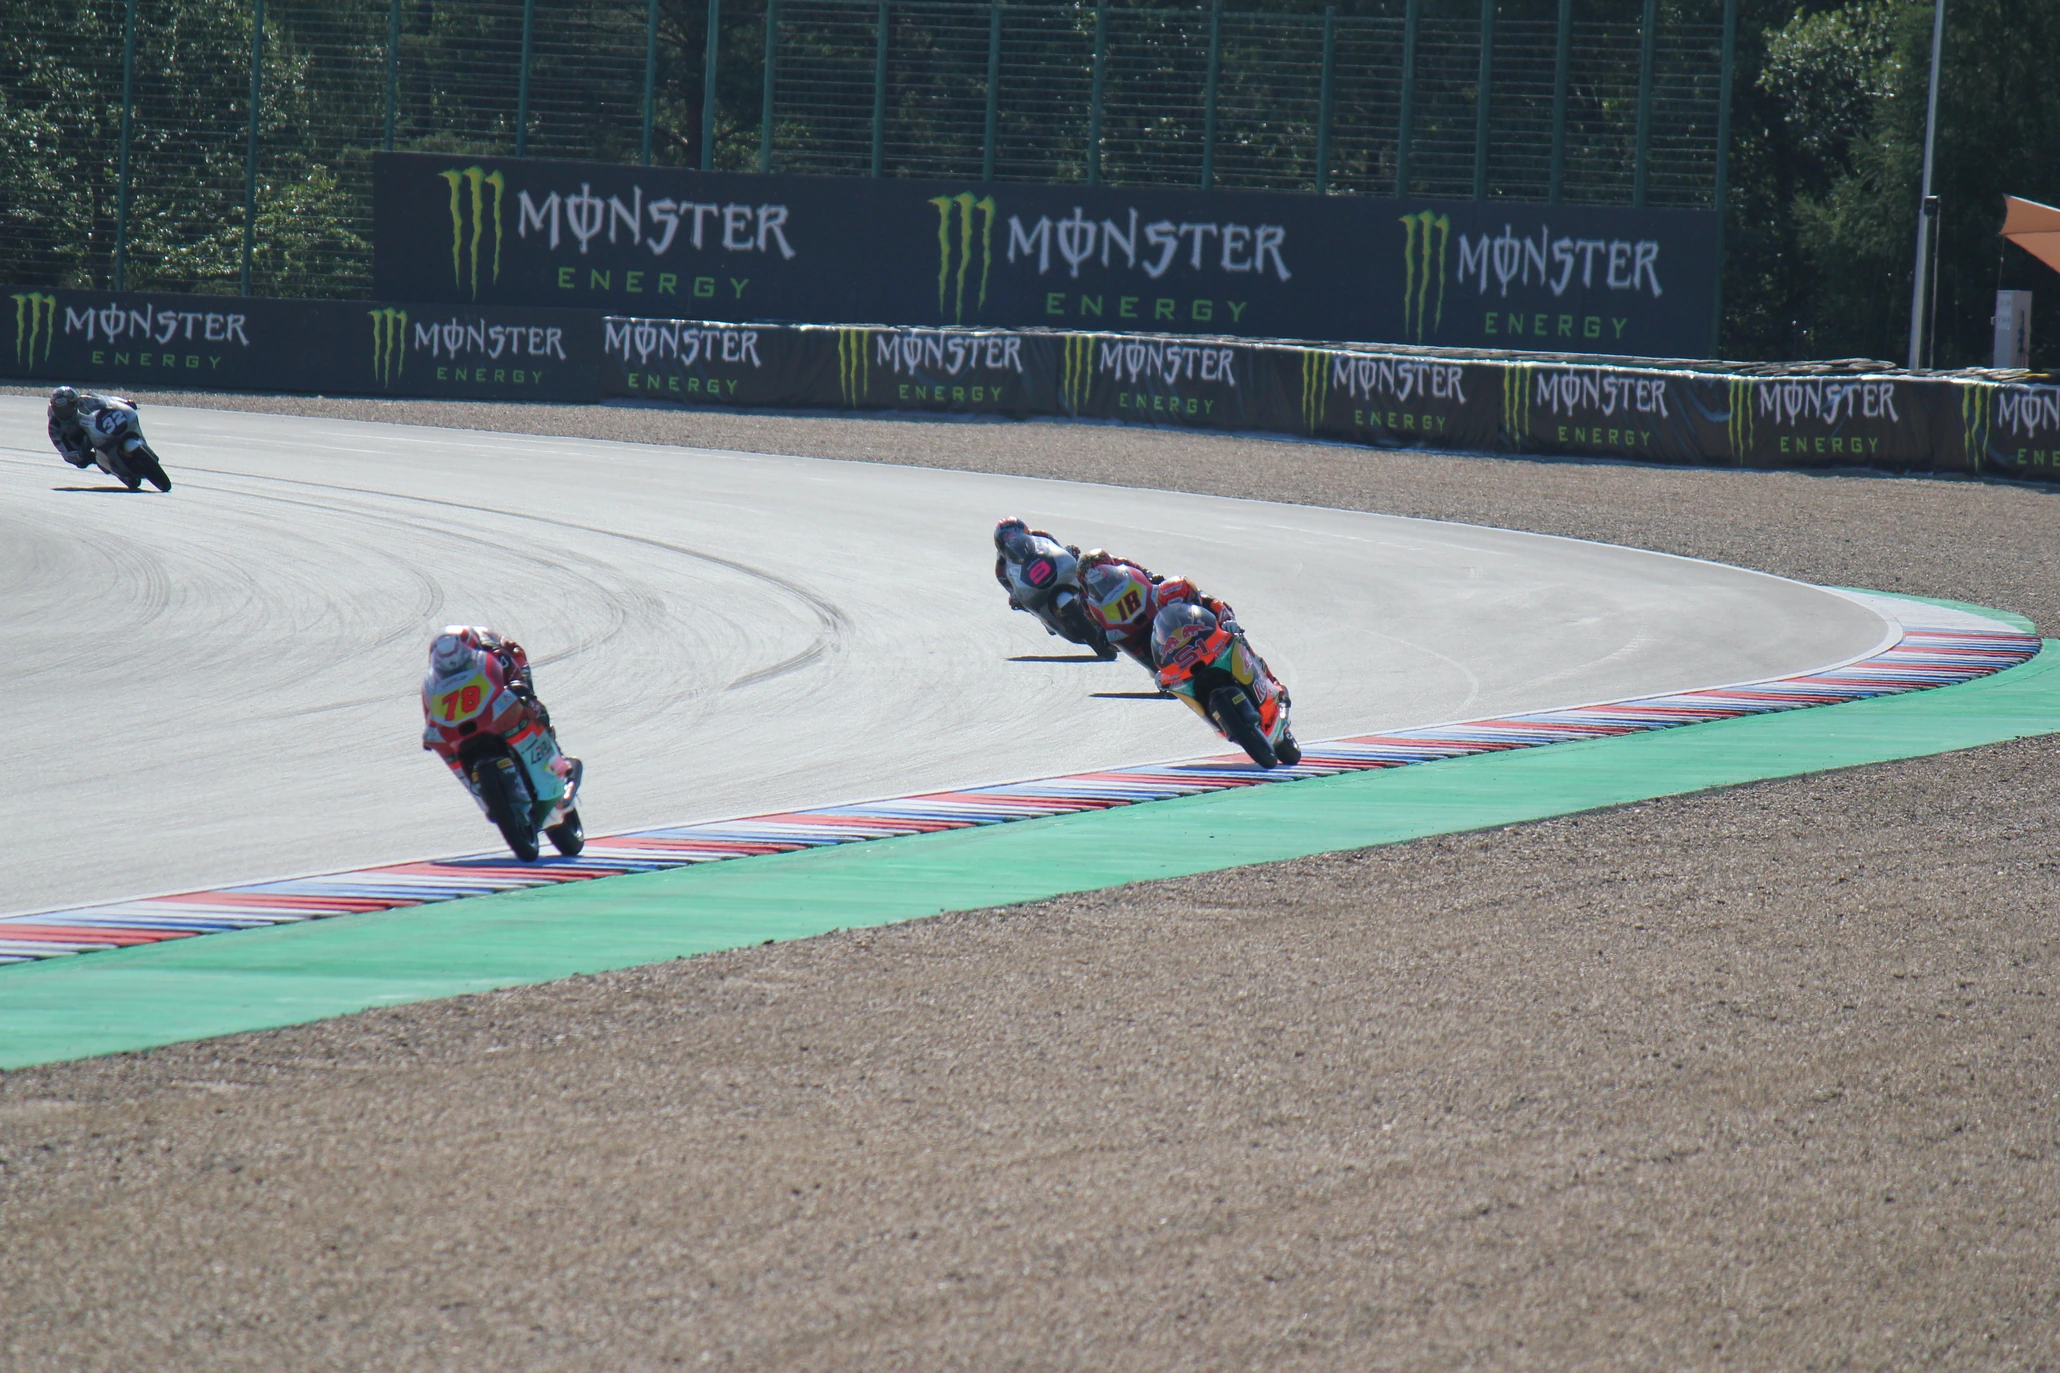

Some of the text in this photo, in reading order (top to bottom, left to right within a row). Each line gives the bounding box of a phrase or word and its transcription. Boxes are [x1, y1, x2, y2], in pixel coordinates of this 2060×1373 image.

[518, 183, 796, 260] MONSTER
[1007, 207, 1291, 281] MONSTER
[1458, 224, 1662, 297] MONSTER
[557, 266, 750, 299] ENERGY
[1046, 292, 1247, 323] ENERGY
[64, 303, 249, 346] MONSTER
[414, 318, 566, 360] MONSTER
[1484, 311, 1628, 339] ENERGY
[91, 350, 222, 369] ENERGY
[604, 319, 762, 368] MONSTER
[876, 331, 1022, 375] MONSTER
[436, 366, 543, 384] ENERGY
[1100, 338, 1235, 387] MONSTER
[627, 372, 738, 394] ENERGY
[898, 383, 1002, 401] ENERGY
[1333, 356, 1466, 404] MONSTER
[1536, 369, 1669, 418] MONSTER
[1119, 392, 1214, 414] ENERGY
[1759, 378, 1899, 426] MONSTER
[102, 409, 127, 435] 32
[1354, 410, 1447, 432] ENERGY
[1558, 425, 1651, 446] ENERGY
[1780, 435, 1879, 453] ENERGY
[1115, 589, 1142, 622] 18
[441, 684, 481, 721] 78
